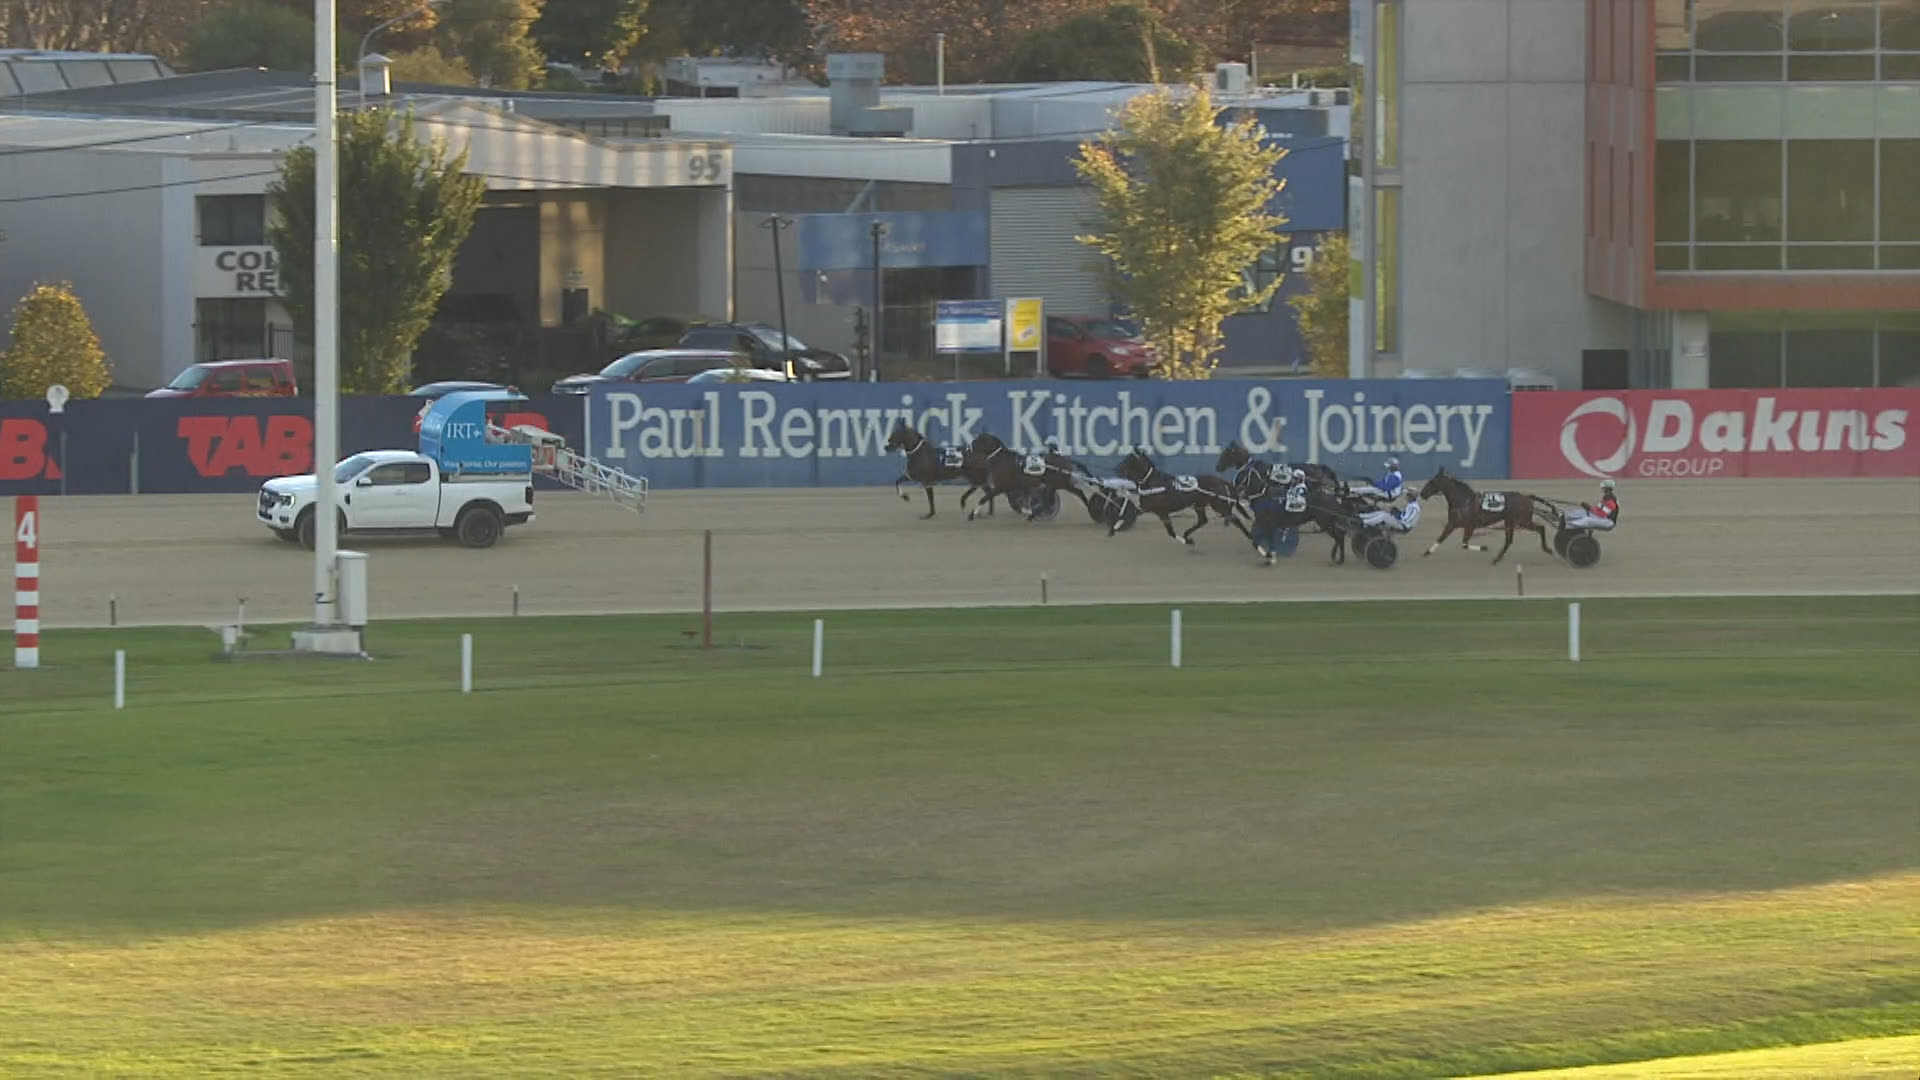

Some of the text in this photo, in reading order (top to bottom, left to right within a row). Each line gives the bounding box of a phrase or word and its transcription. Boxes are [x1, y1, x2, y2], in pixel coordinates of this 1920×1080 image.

[689, 154, 721, 181] 95
[176, 415, 315, 478] TAB
[606, 391, 724, 459] Paul
[1007, 389, 1224, 458] Kitchen
[1240, 387, 1288, 454] &
[1304, 389, 1493, 468] Joinery
[1642, 397, 1909, 452] Dakins
[1639, 458, 1723, 477] GROUP
[17, 511, 36, 549] 4
